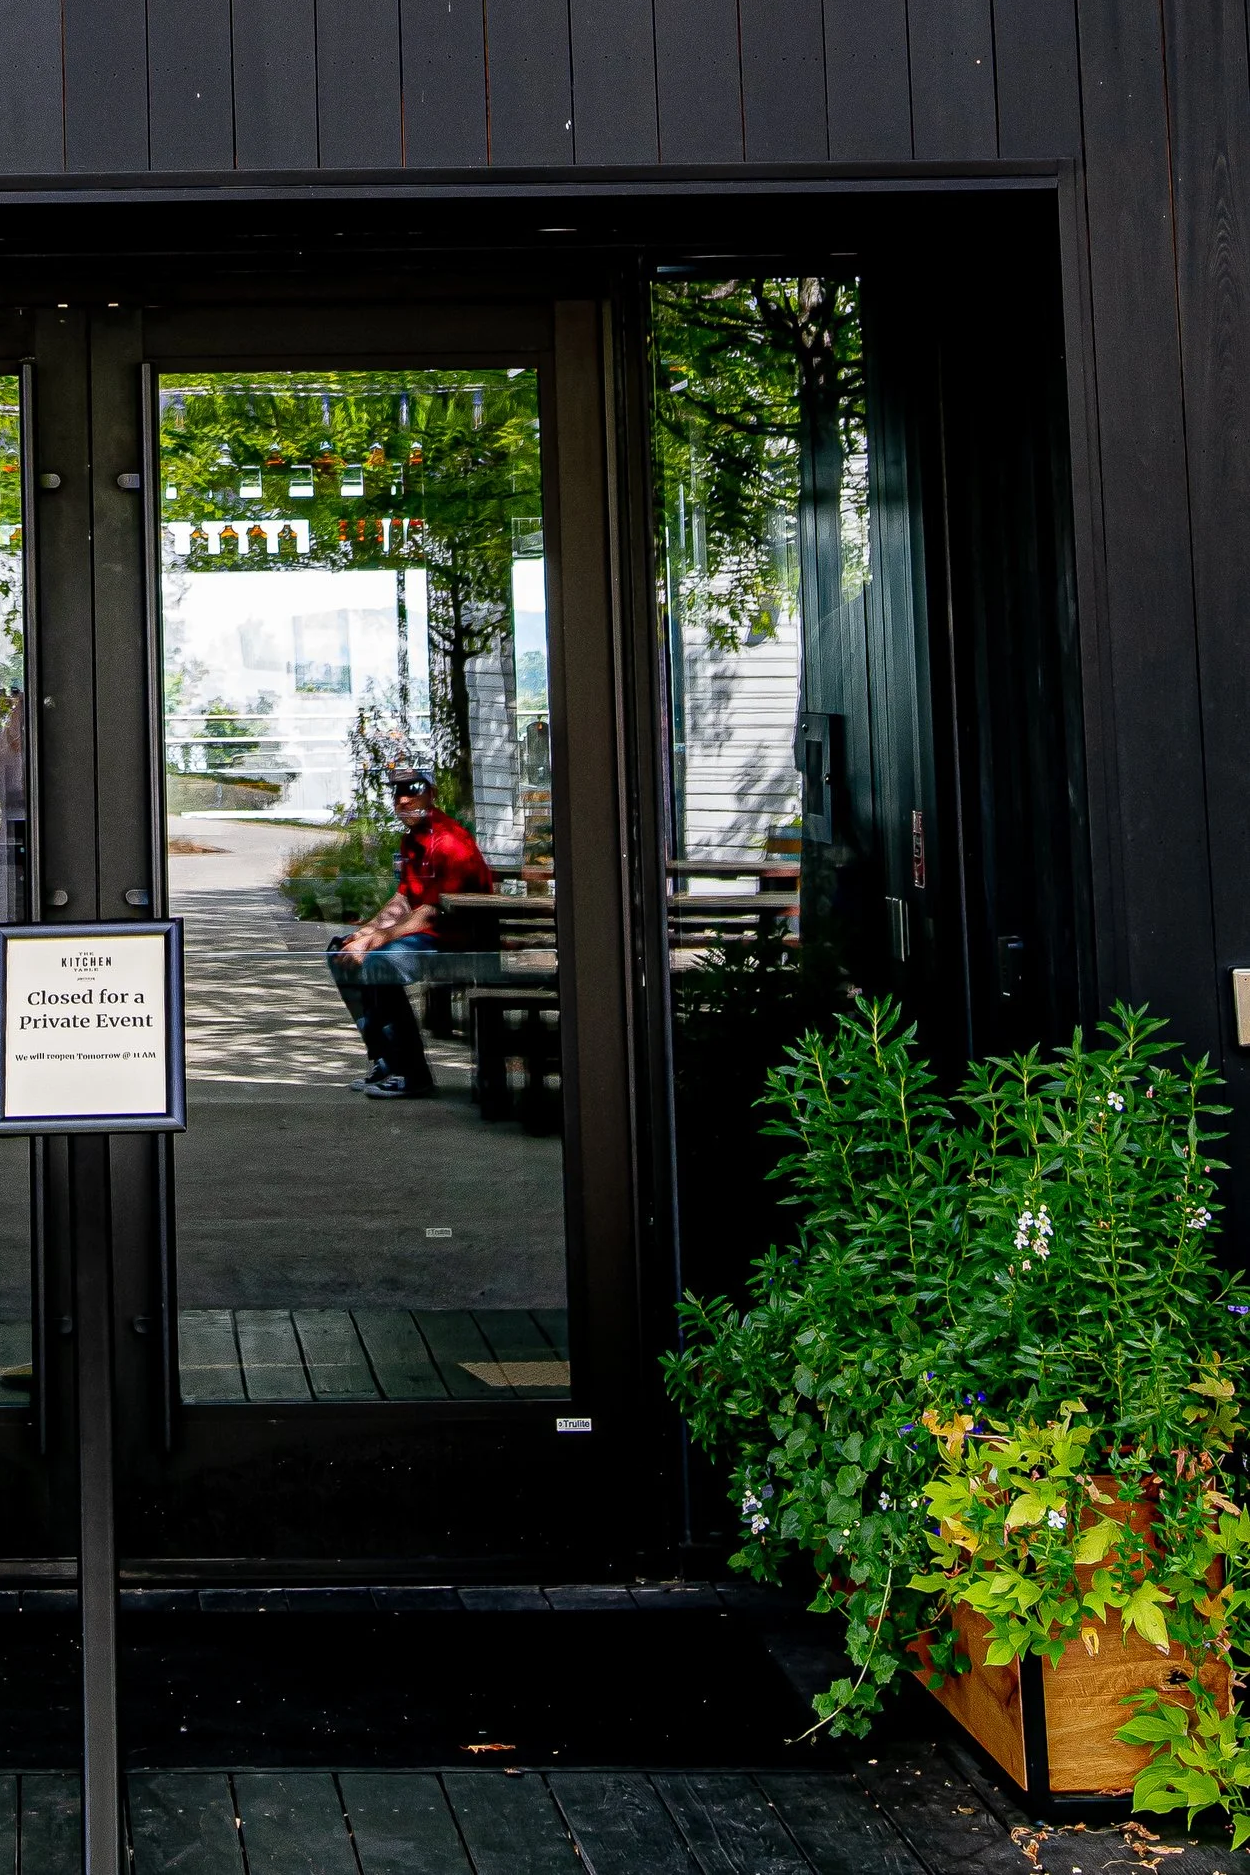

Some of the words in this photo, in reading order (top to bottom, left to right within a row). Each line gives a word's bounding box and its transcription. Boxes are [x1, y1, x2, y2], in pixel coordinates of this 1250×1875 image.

[61, 957, 112, 967] KITCHEN
[27, 989, 94, 1006] Closed
[98, 988, 129, 1004] for
[133, 992, 145, 1004] a
[19, 1014, 91, 1030] Private
[96, 1013, 154, 1028] Event
[29, 1052, 45, 1060] will
[46, 1053, 75, 1061] reopen
[76, 1052, 121, 1060] Tomorrow
[122, 1051, 131, 1060] @
[563, 1420, 590, 1428] Trulite
